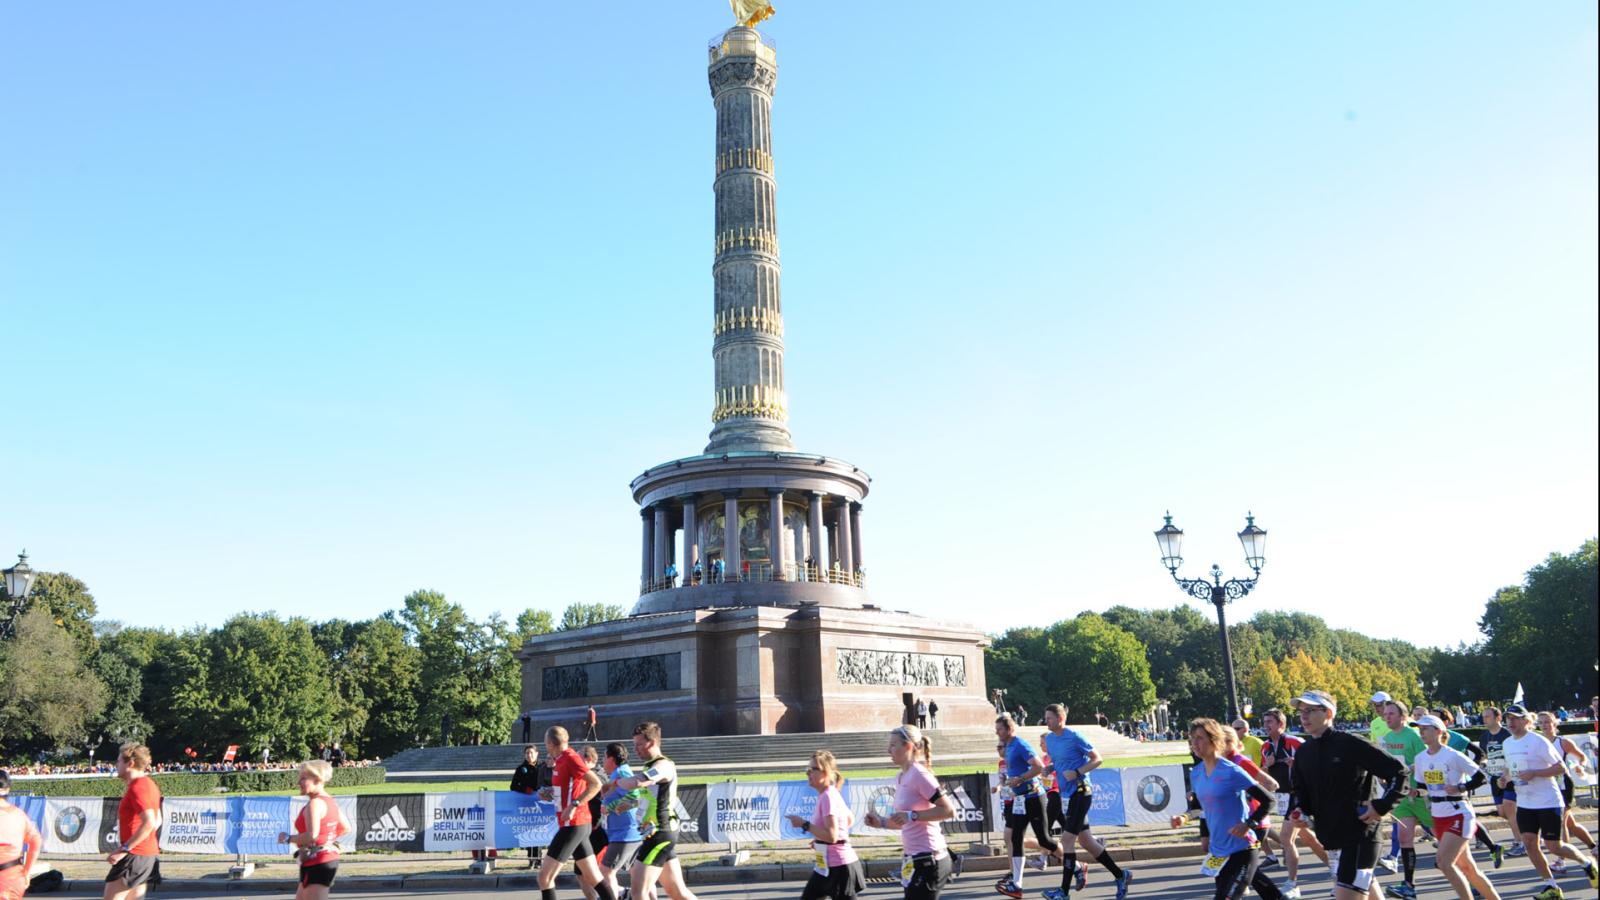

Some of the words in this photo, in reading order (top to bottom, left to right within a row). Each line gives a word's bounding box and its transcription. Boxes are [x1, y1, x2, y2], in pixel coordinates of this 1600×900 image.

[716, 798, 749, 811] BMW
[433, 807, 466, 820] BMW
[518, 806, 543, 815] TATA
[170, 811, 199, 824] BMW
[247, 812, 269, 820] TATA
[501, 815, 556, 824] CONSULTANC
[716, 812, 750, 822] BERLIN
[169, 825, 199, 834] BERLIN
[232, 820, 285, 830] CONSULTANCY
[433, 821, 466, 831] BERLIN
[511, 825, 549, 834] SERVICES
[717, 822, 770, 833] MARATHON
[241, 830, 276, 839] SERVICES
[365, 828, 416, 842] adidas
[433, 831, 485, 842] MARATHON
[167, 835, 216, 845] MARATHON
